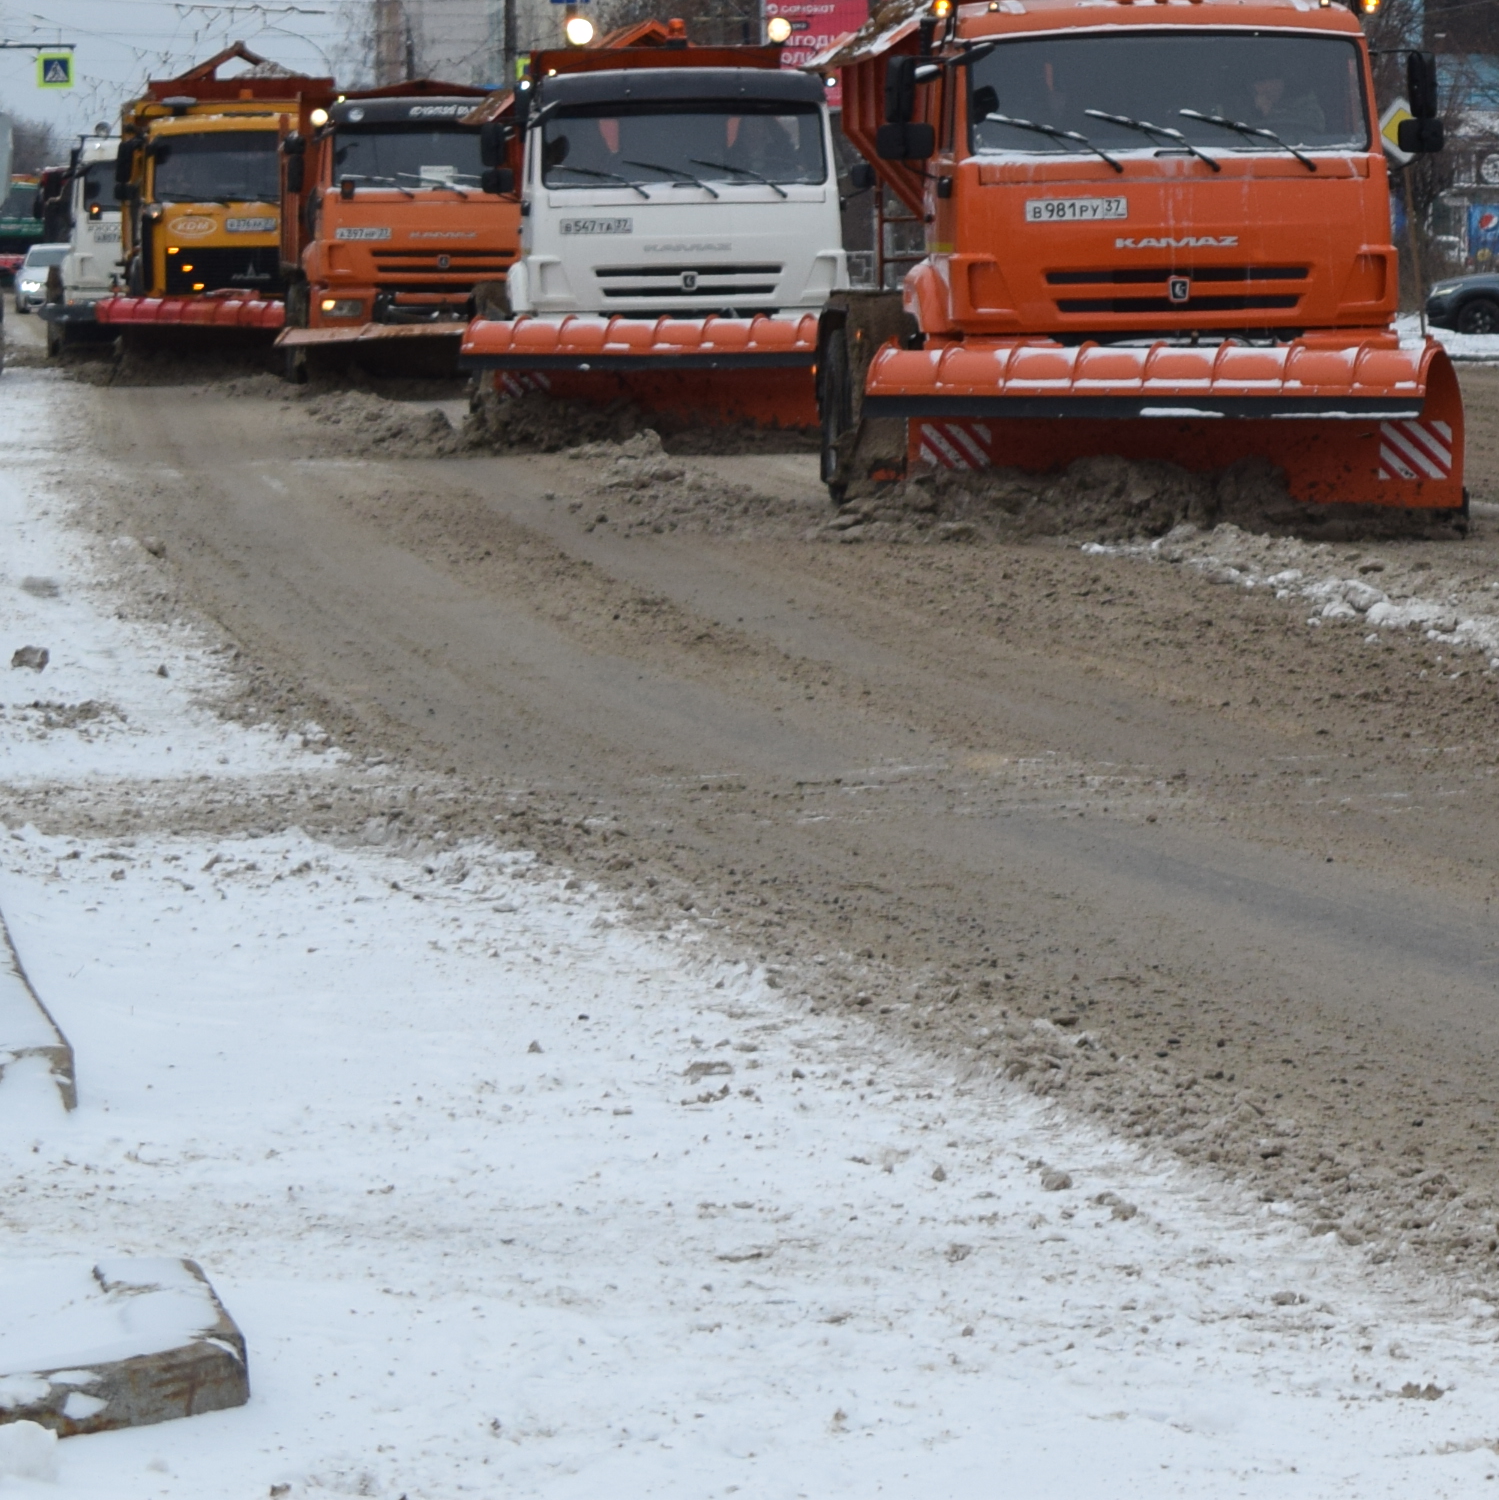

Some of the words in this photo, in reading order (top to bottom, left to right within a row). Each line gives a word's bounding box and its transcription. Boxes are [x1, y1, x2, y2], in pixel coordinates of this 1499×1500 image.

[1032, 201, 1100, 219] В981РУ
[1104, 199, 1121, 213] 37
[1115, 236, 1239, 249] KAMAZ
